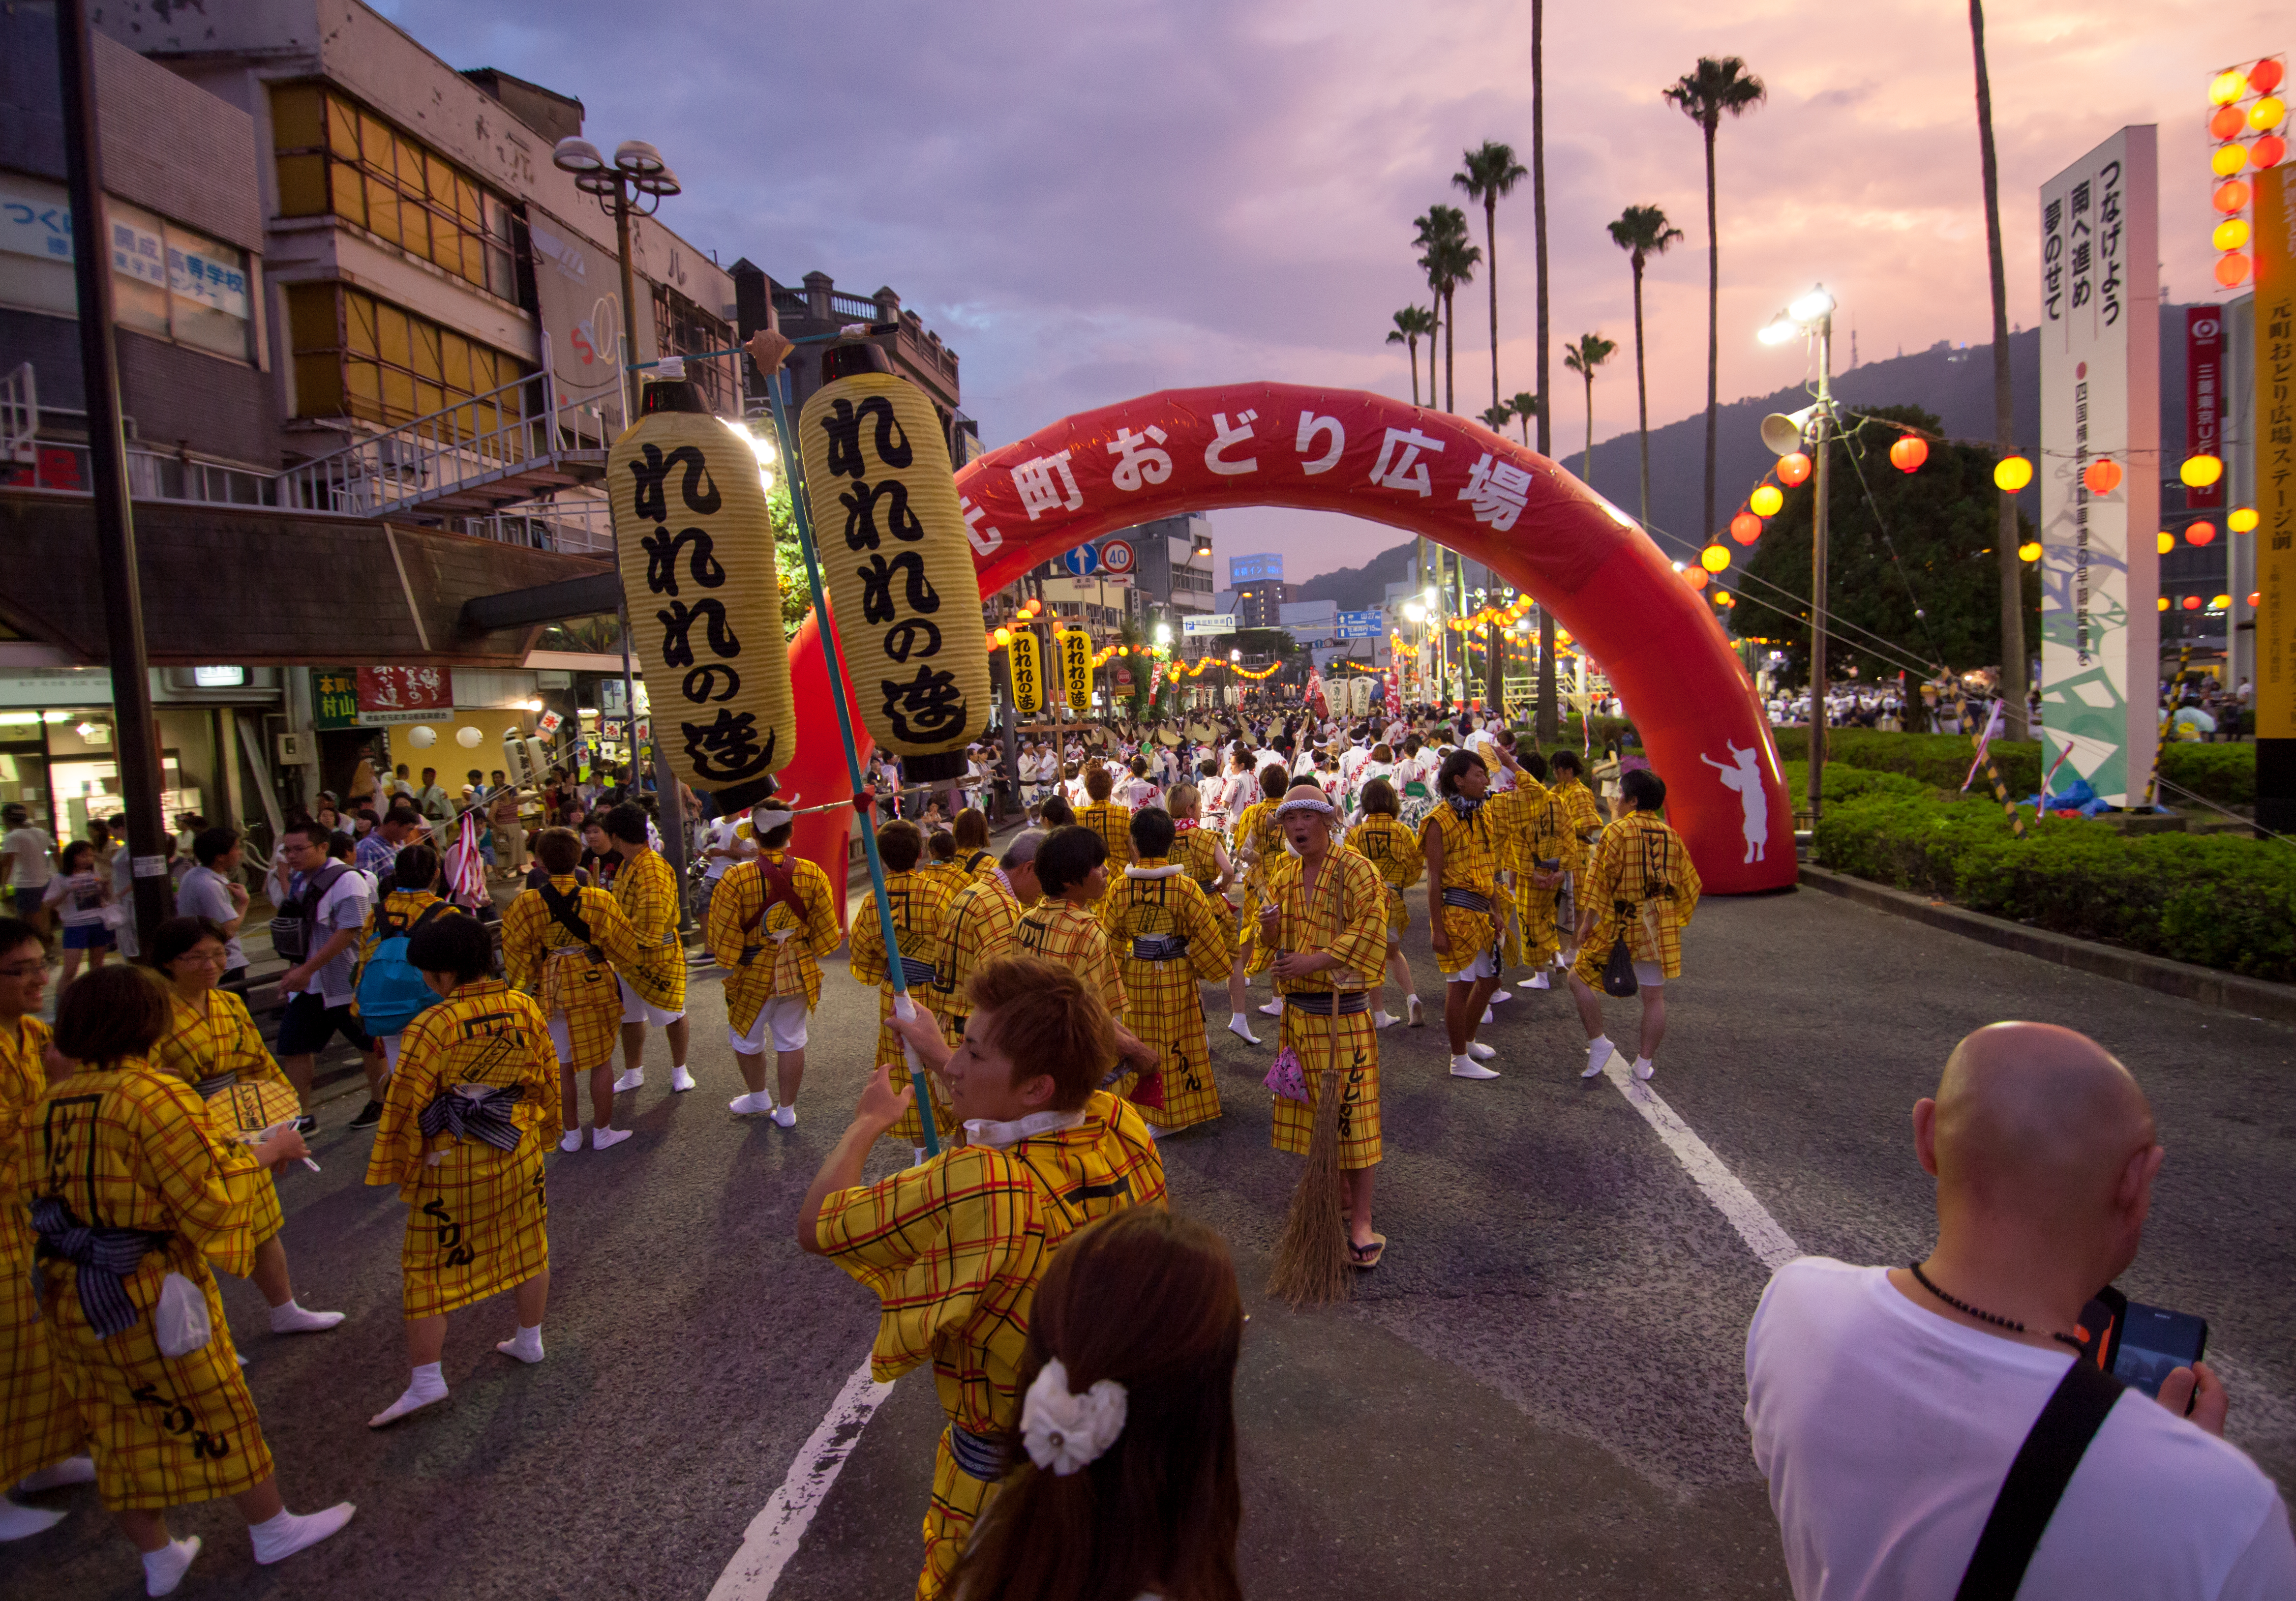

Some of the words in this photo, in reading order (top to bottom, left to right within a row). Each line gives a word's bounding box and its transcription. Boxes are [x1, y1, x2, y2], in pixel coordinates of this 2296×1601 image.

[2044, 198, 2062, 320] 夢のせて
[2071, 178, 2091, 309] 南へ進め
[2100, 159, 2120, 326] つなげよう
[2269, 298, 2293, 550] 元町おどり広場ステージ前
[1109, 550, 1126, 564] 40
[1234, 566, 1262, 577] 東横イン
[1014, 638, 1035, 710] れれれの連
[1067, 635, 1087, 707] れれれの連
